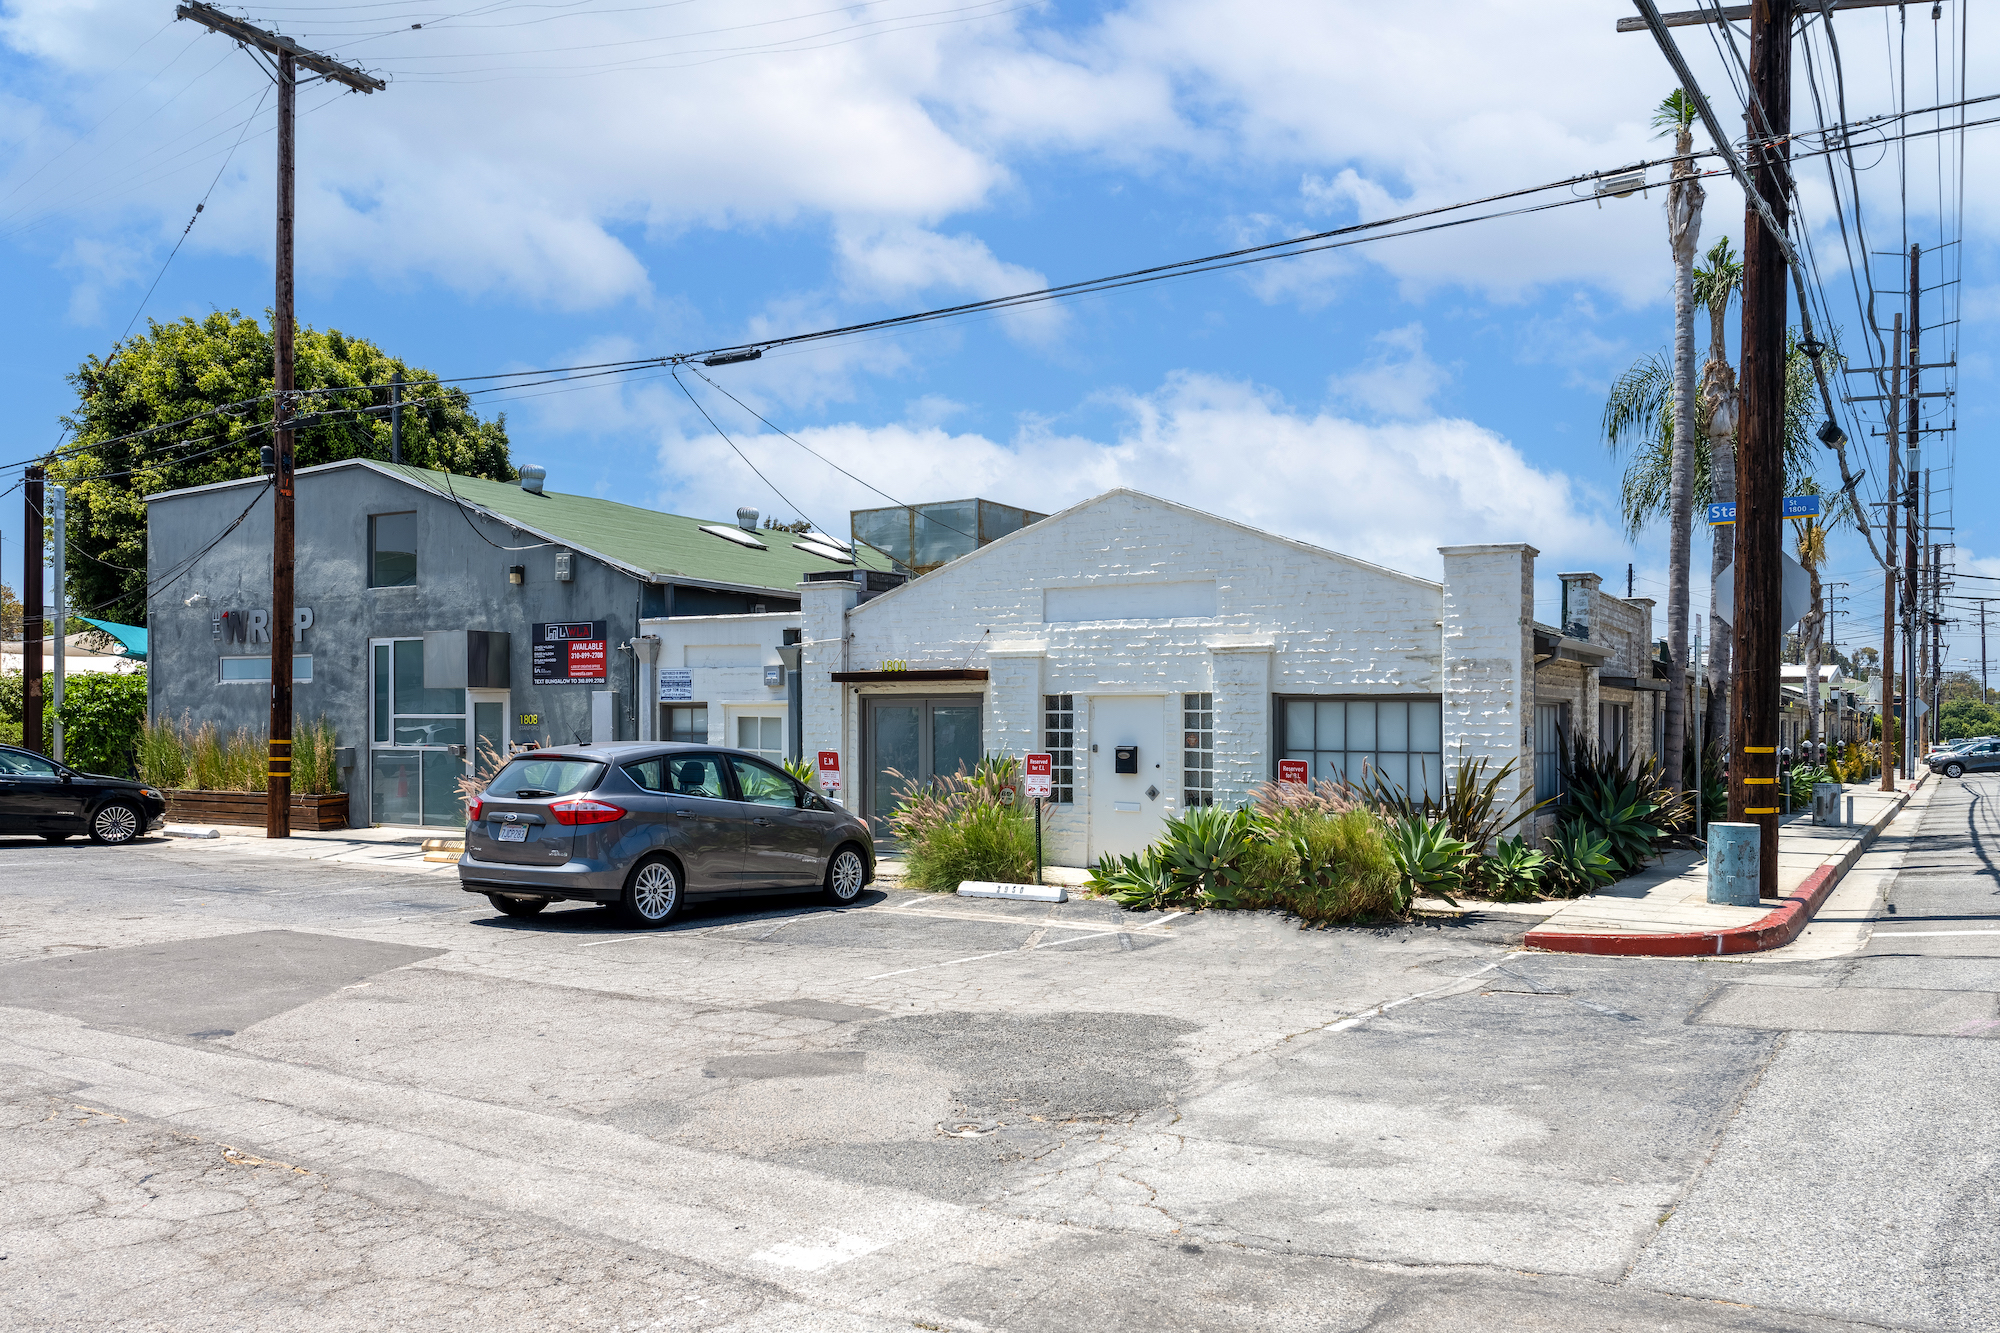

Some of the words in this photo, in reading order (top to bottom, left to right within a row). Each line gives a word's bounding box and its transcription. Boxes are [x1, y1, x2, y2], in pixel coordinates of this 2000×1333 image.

[1711, 506, 1737, 518] Sta
[221, 608, 314, 645] WRP
[882, 660, 906, 672] 1800
[520, 714, 538, 724] 1808
